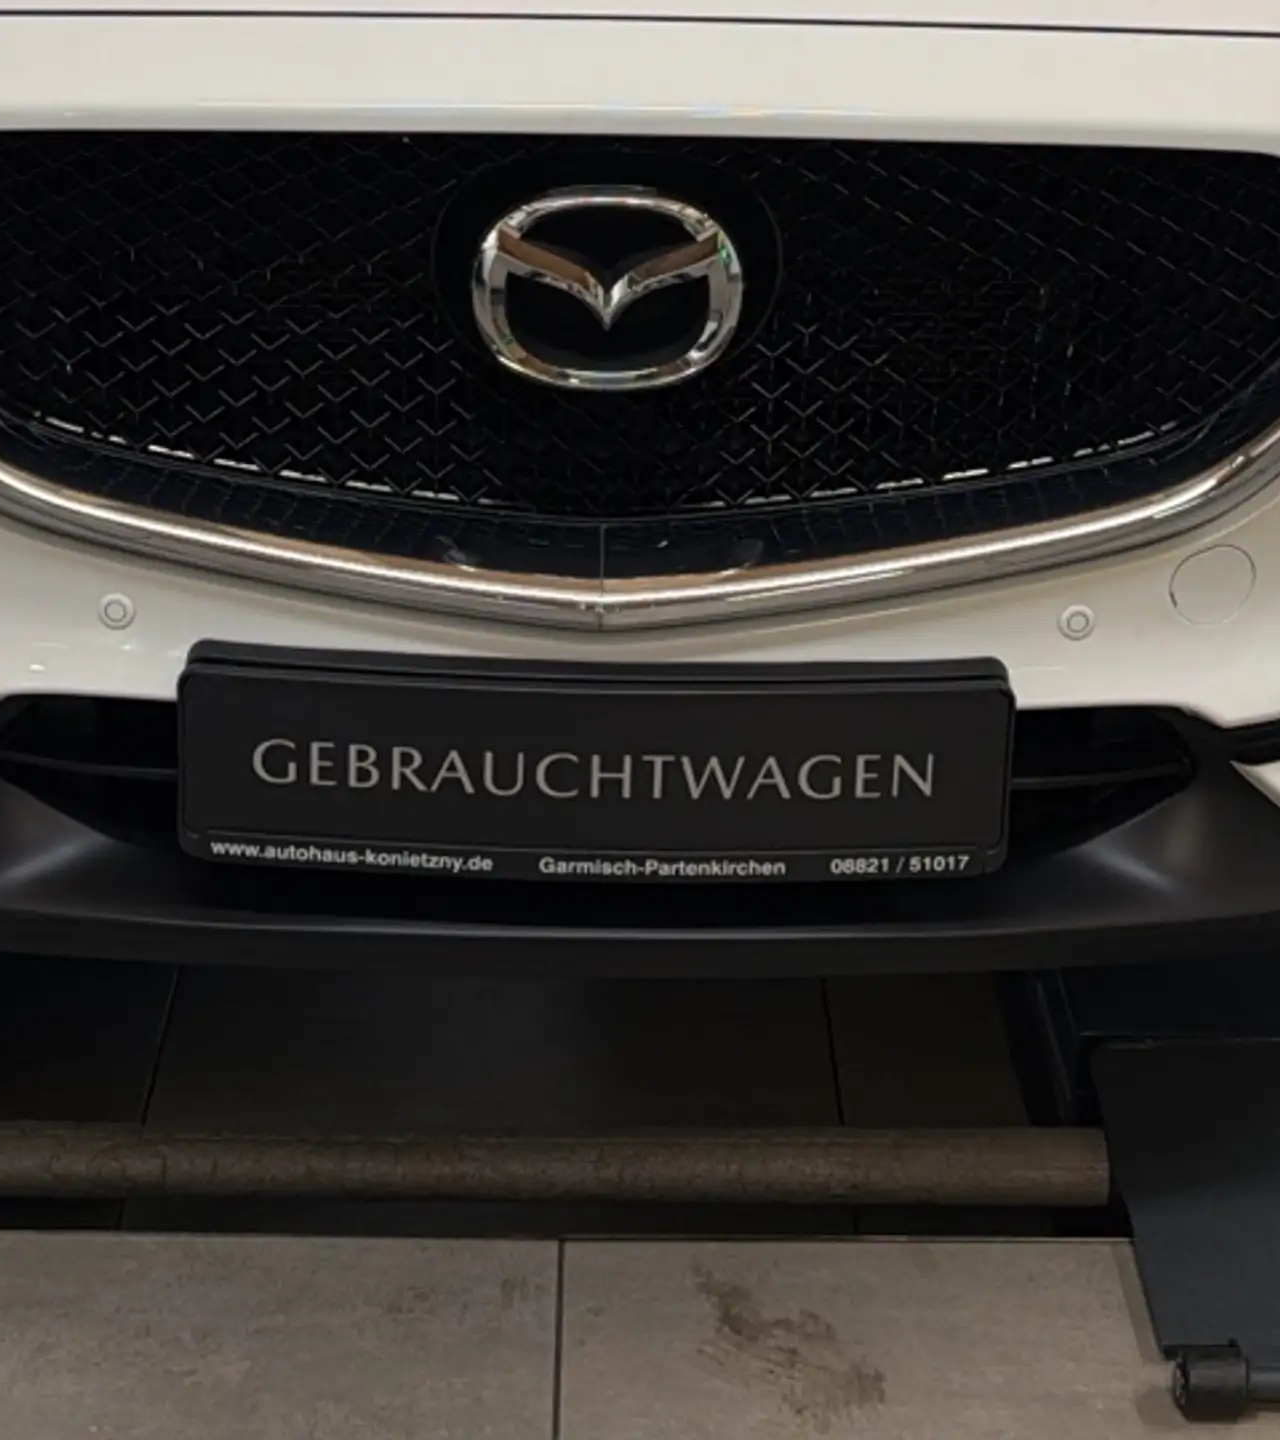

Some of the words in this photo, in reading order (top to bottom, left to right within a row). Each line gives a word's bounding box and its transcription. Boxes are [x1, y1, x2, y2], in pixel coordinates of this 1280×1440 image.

[252, 738, 935, 800] GEBRAUCHTWAGEN
[210, 840, 493, 873] www.autohaus-konietzny.de
[538, 856, 787, 876] Garmisch-Partenkirchen
[830, 857, 890, 874] 08821
[909, 855, 970, 872] 51017
